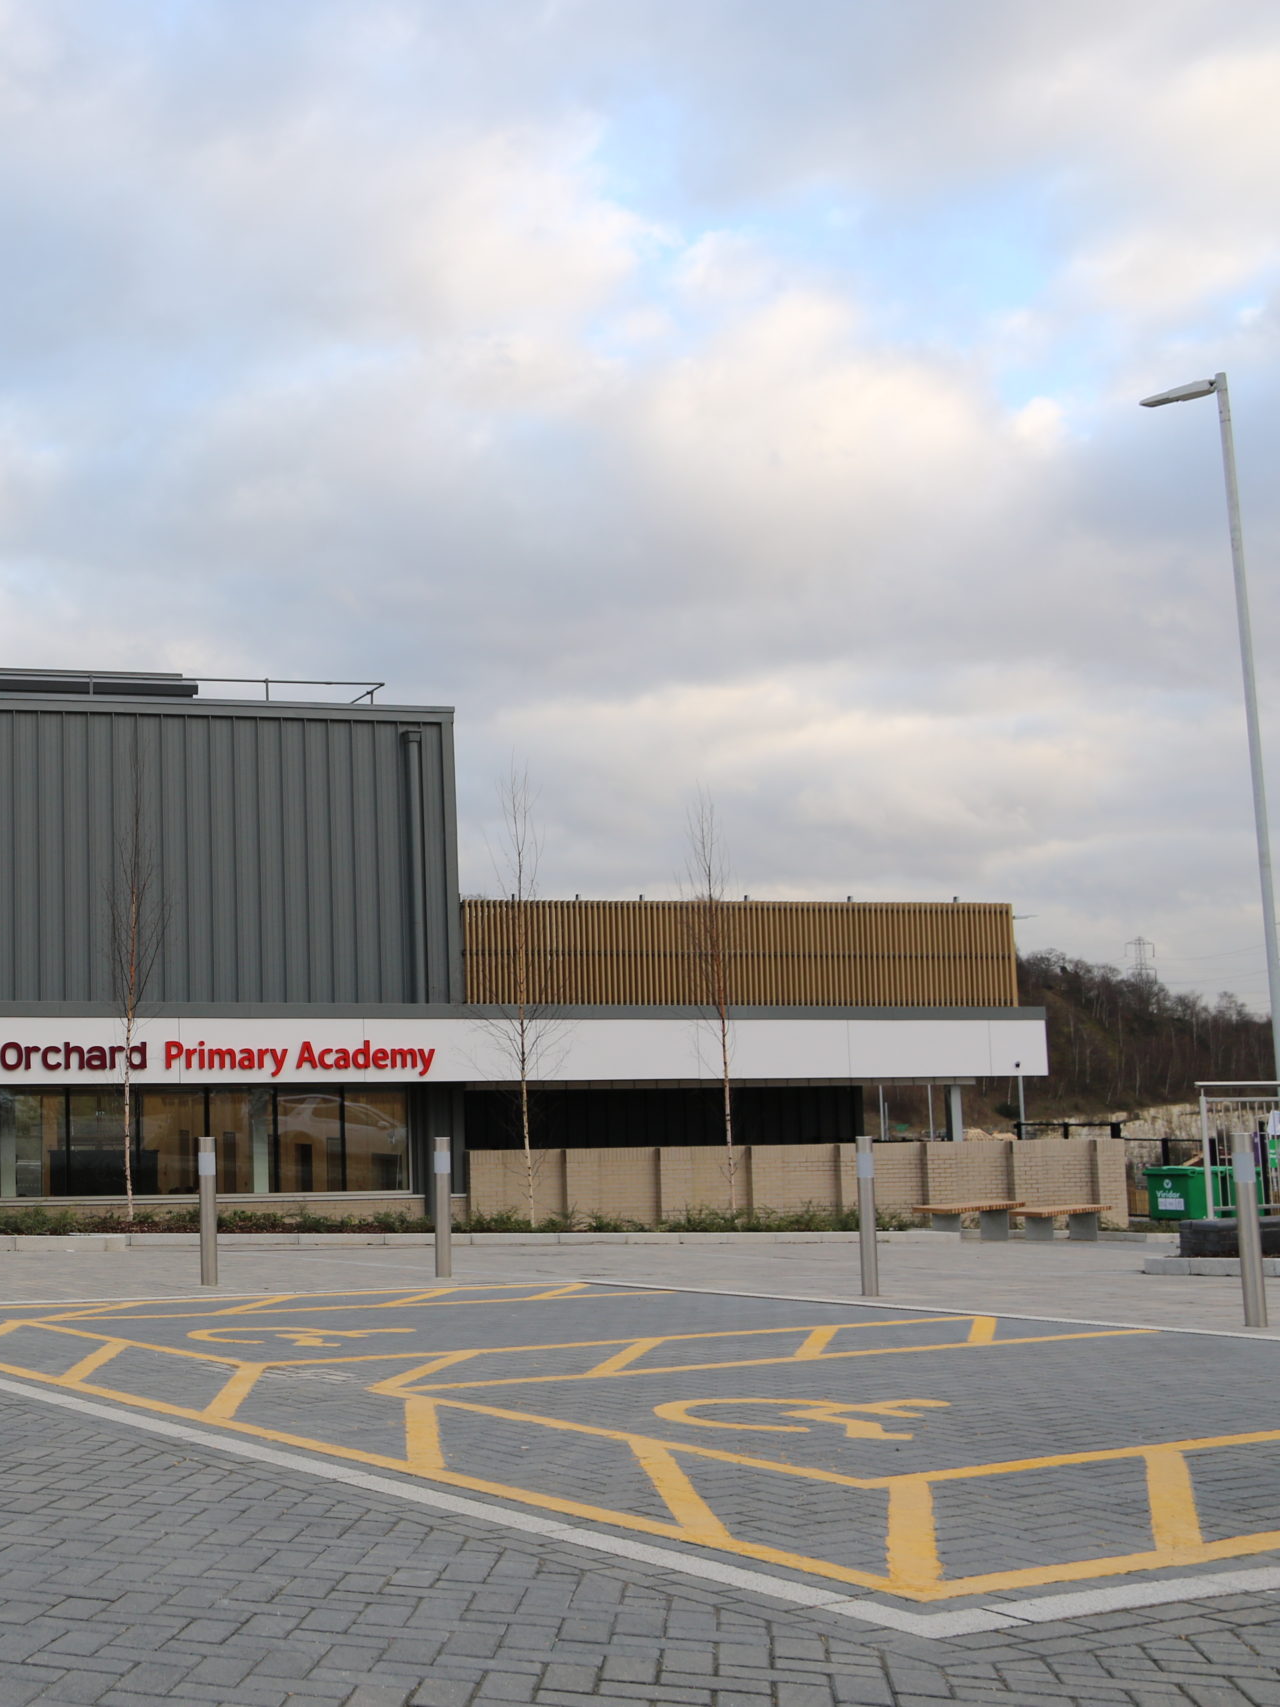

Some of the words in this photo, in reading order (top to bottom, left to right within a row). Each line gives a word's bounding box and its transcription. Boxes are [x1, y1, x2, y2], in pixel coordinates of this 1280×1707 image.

[0, 1041, 147, 1070] Orchard
[164, 1041, 289, 1076] Primary
[296, 1041, 436, 1076] Academy
